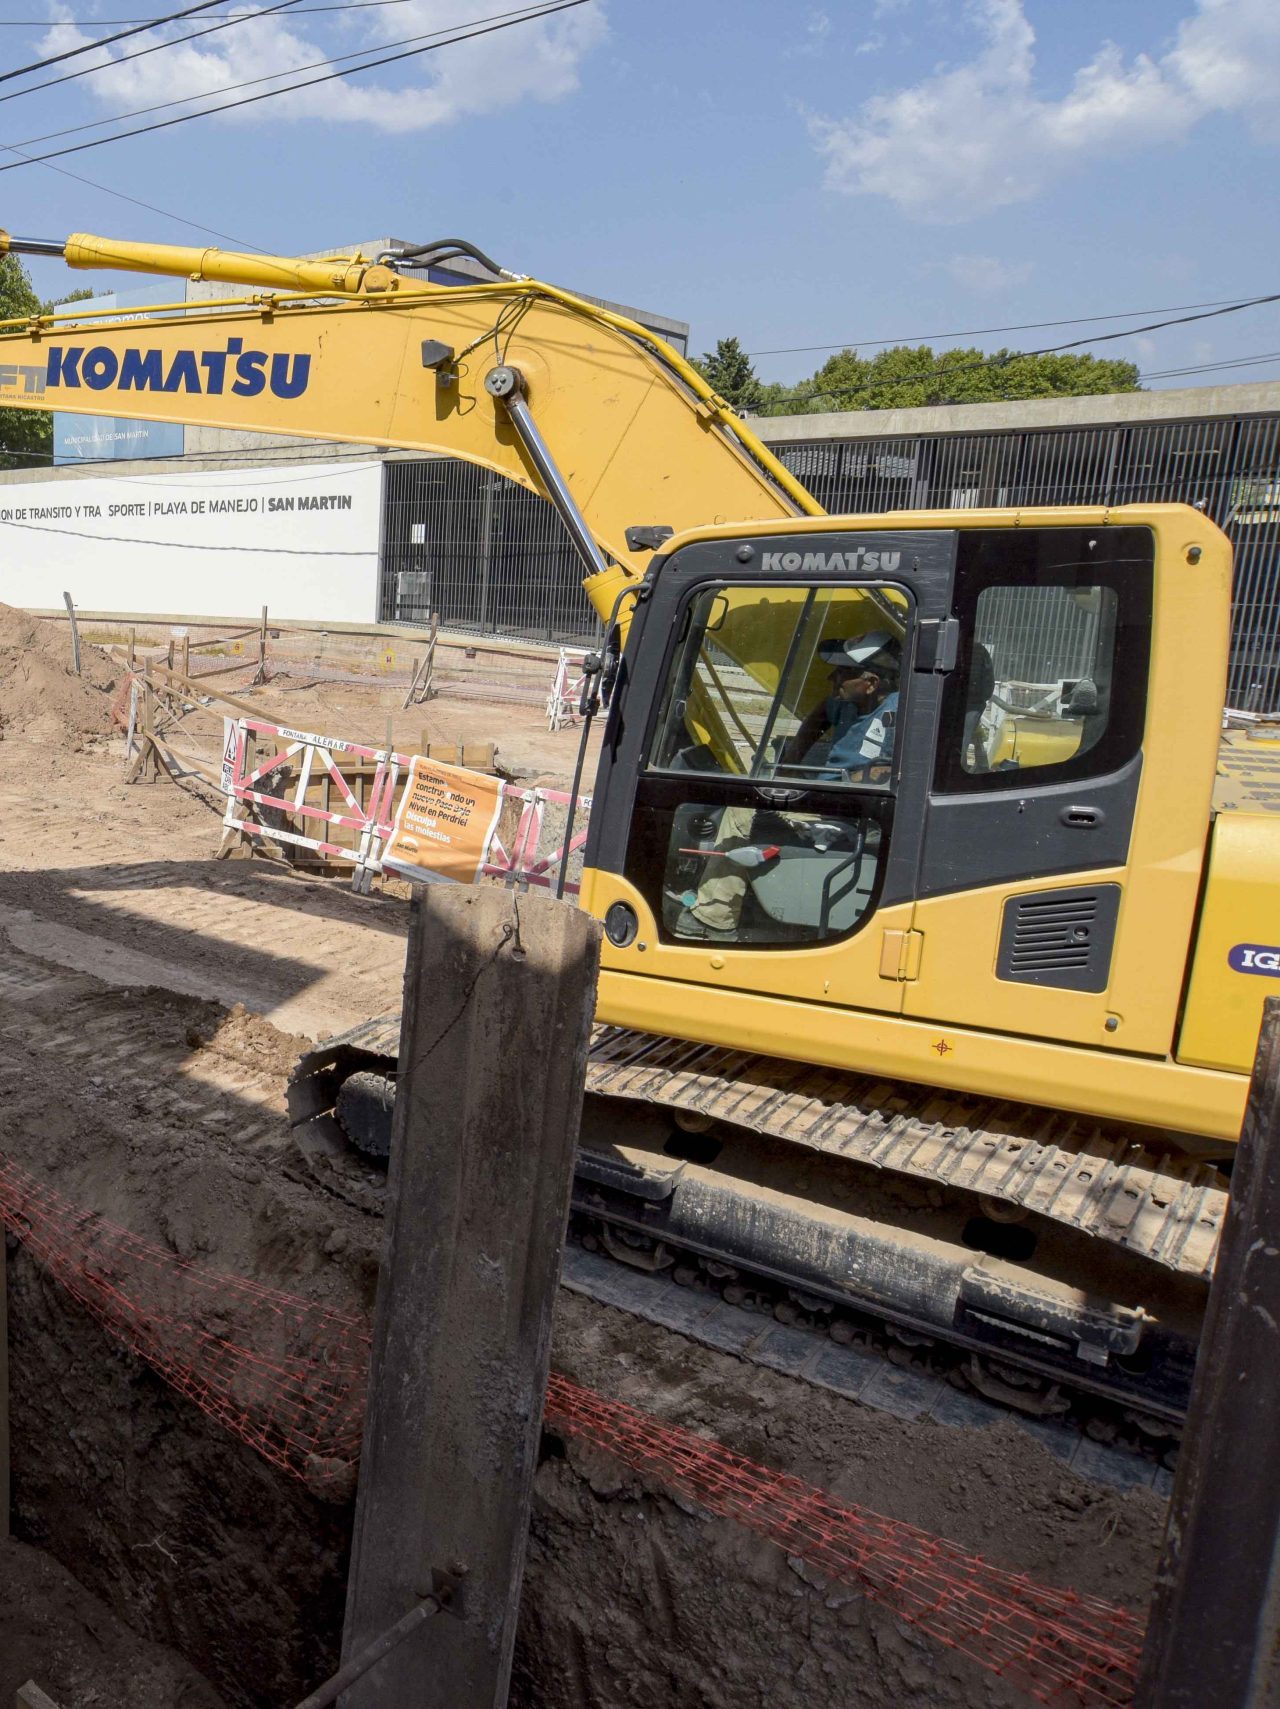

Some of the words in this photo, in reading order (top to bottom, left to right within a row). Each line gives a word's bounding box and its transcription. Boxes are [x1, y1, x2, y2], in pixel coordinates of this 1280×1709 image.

[46, 337, 311, 399] KOMATSU
[115, 432, 126, 440] SAN
[15, 508, 27, 520] DE
[29, 506, 72, 519] TRANSITO
[74, 505, 81, 518] Y
[154, 501, 188, 515] PLAYA
[191, 500, 206, 514] DE
[209, 498, 258, 513] MANEJO
[268, 497, 295, 512] SAN
[297, 495, 352, 510] MARTIN
[761, 547, 901, 572] KOMATSU
[409, 801, 427, 814] Nivel
[427, 807, 437, 817] en
[465, 797, 476, 807] un
[404, 820, 414, 831] las
[415, 826, 451, 843] molestias
